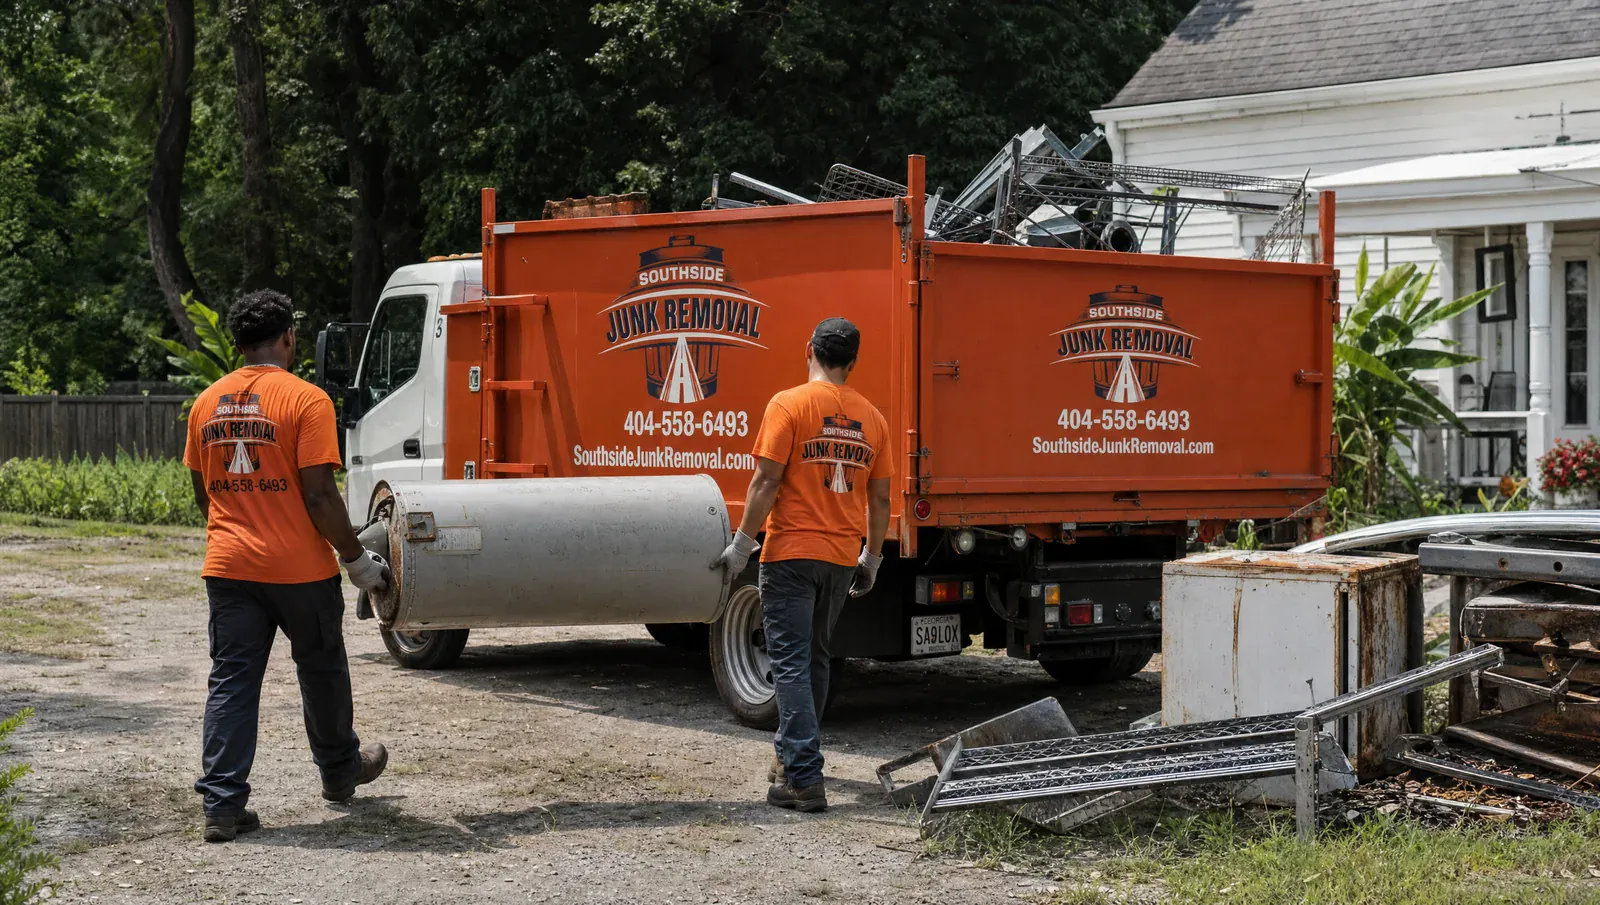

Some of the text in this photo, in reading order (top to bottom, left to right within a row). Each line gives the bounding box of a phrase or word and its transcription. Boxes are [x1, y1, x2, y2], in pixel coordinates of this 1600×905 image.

[639, 266, 724, 286] SOUTHSIDE
[606, 297, 761, 343] JUNK REMOVAL
[1089, 306, 1163, 321] SOUTHSIDE
[1057, 328, 1193, 359] JUNK REMOVAL
[216, 405, 259, 415] SOUTHSIDE
[1057, 408, 1190, 431] 404-558-6493
[623, 410, 748, 437] 404-558-6493
[823, 427, 863, 439] SOUTHSIDE
[201, 424, 227, 444] JUNK
[802, 442, 831, 459] JUNK
[1032, 436, 1214, 455] SouthsideJunkRemoval.com
[573, 444, 755, 471] SouthsideJunkRemoval.com
